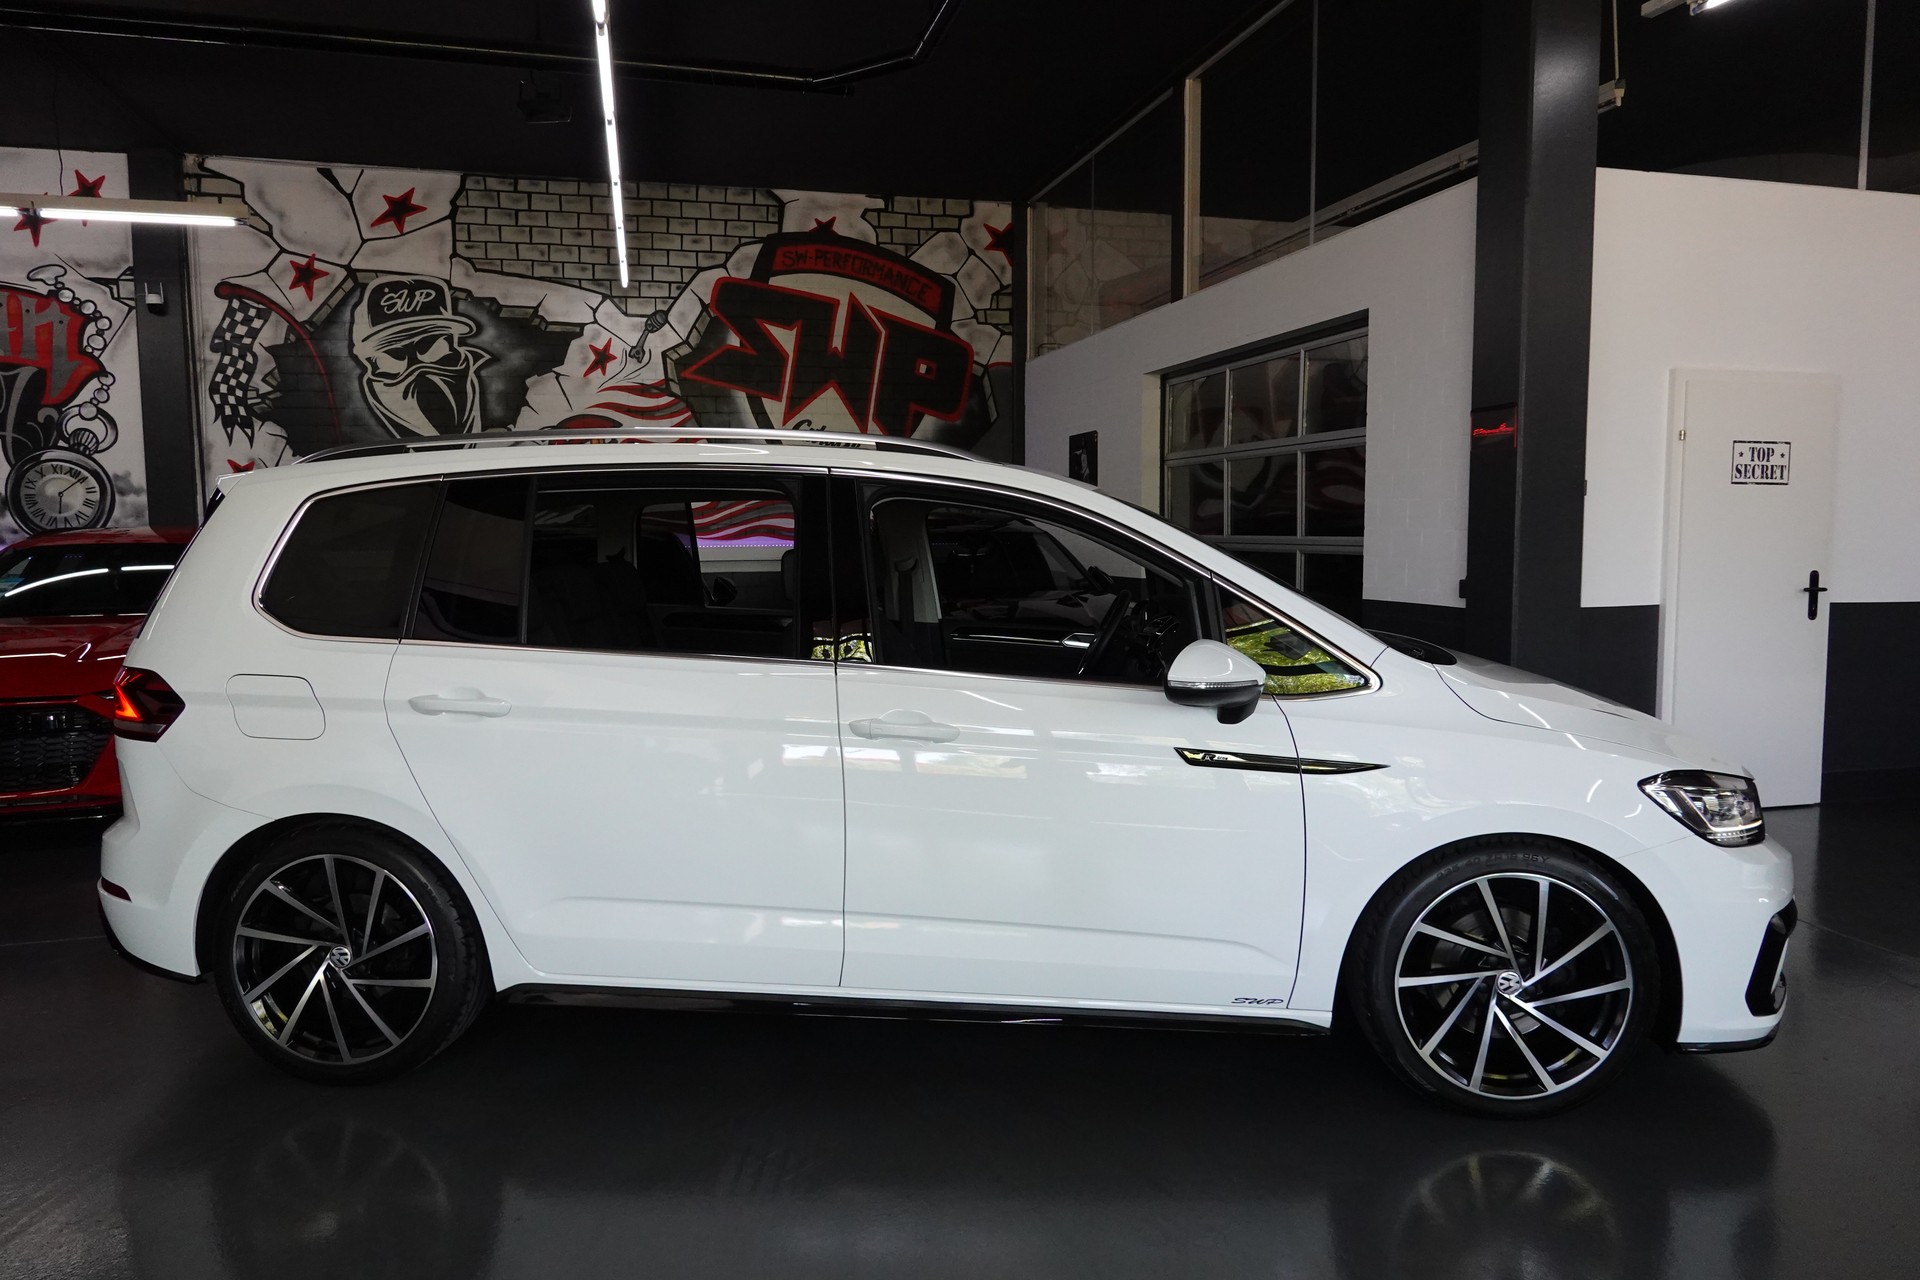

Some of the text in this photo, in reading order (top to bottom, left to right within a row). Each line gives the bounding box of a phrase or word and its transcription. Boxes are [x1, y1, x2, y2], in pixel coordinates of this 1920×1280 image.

[781, 250, 933, 301] SW-PERFORMANCE
[380, 289, 436, 314] SWP
[681, 277, 974, 438] SWP
[1748, 446, 1775, 462] TOP
[1734, 463, 1787, 480] SECRET
